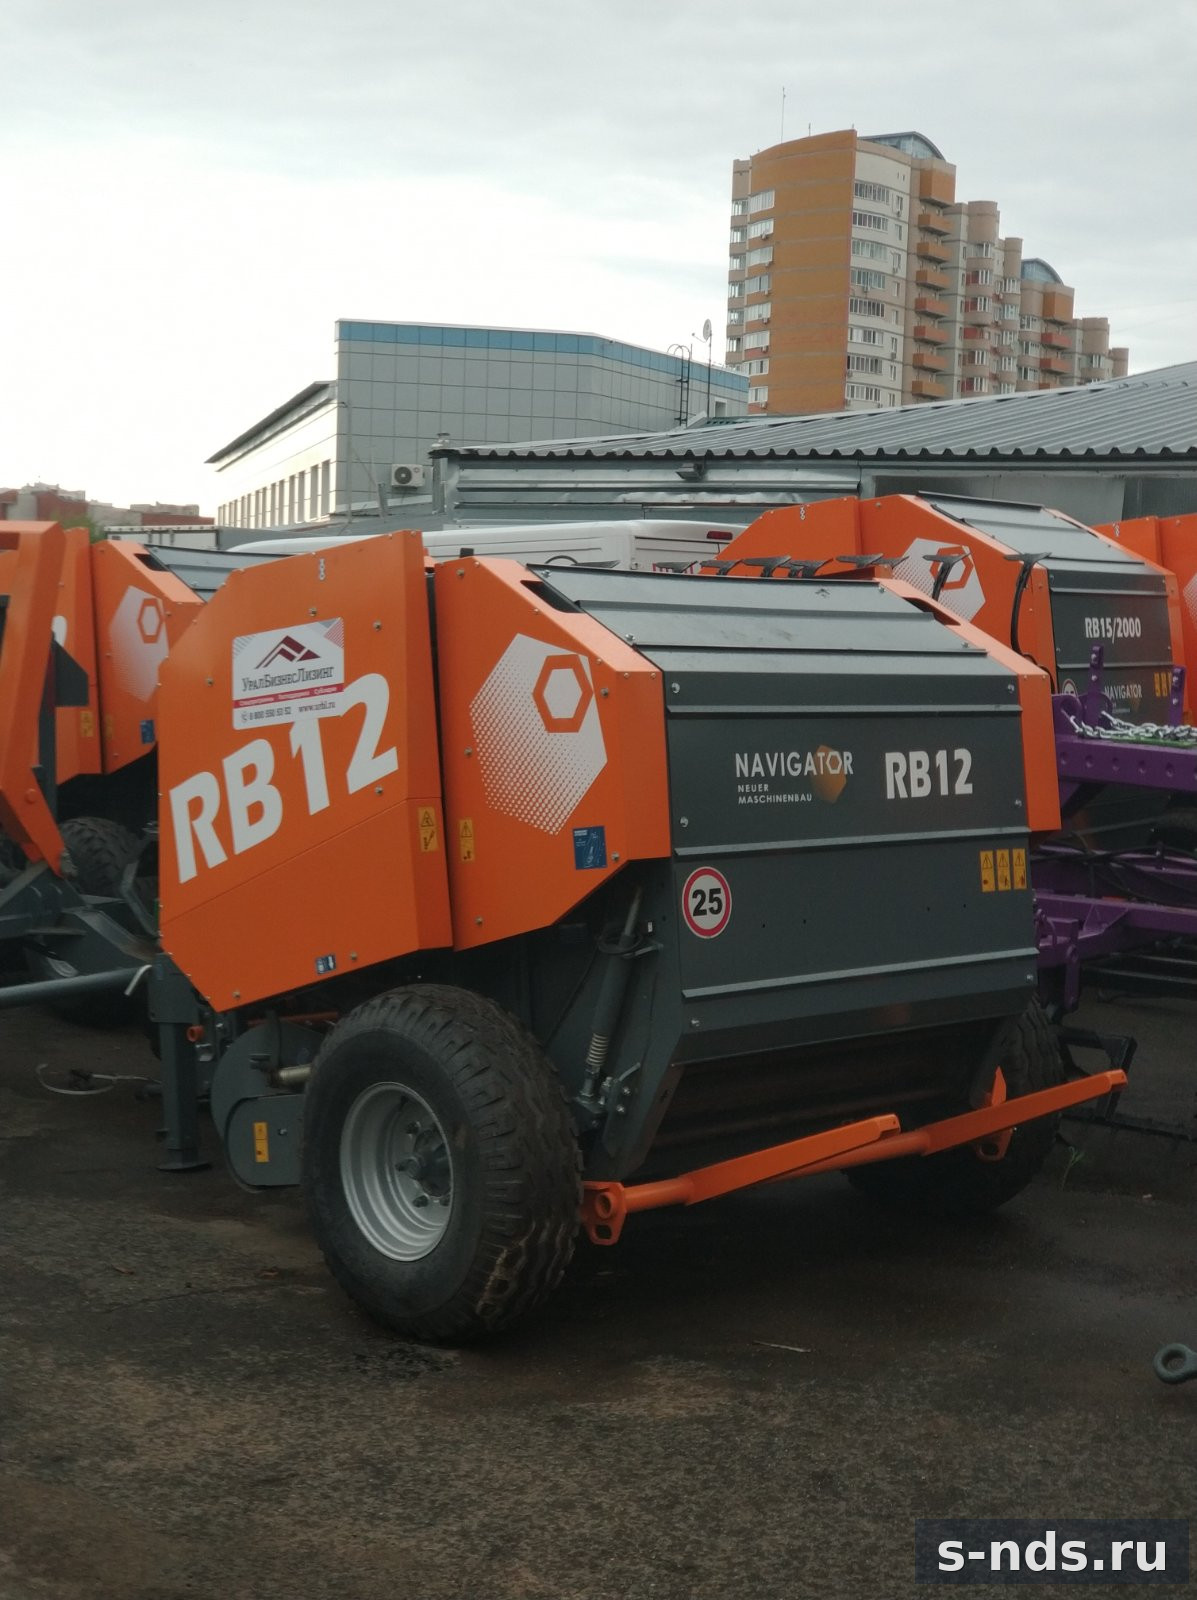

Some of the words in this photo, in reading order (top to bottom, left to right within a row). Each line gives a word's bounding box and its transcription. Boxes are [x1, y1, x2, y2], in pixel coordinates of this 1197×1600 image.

[1084, 617, 1141, 644] RB15/2000
[241, 667, 335, 692] УралБизнесЛизинг
[1104, 684, 1143, 699] NAVIGATOR
[735, 751, 854, 778] NAVIGATOR
[885, 748, 973, 799] RB12
[169, 673, 399, 884] RB12
[738, 783, 769, 793] NEUER
[738, 793, 813, 805] MASCHINENBAU
[692, 888, 723, 916] 25
